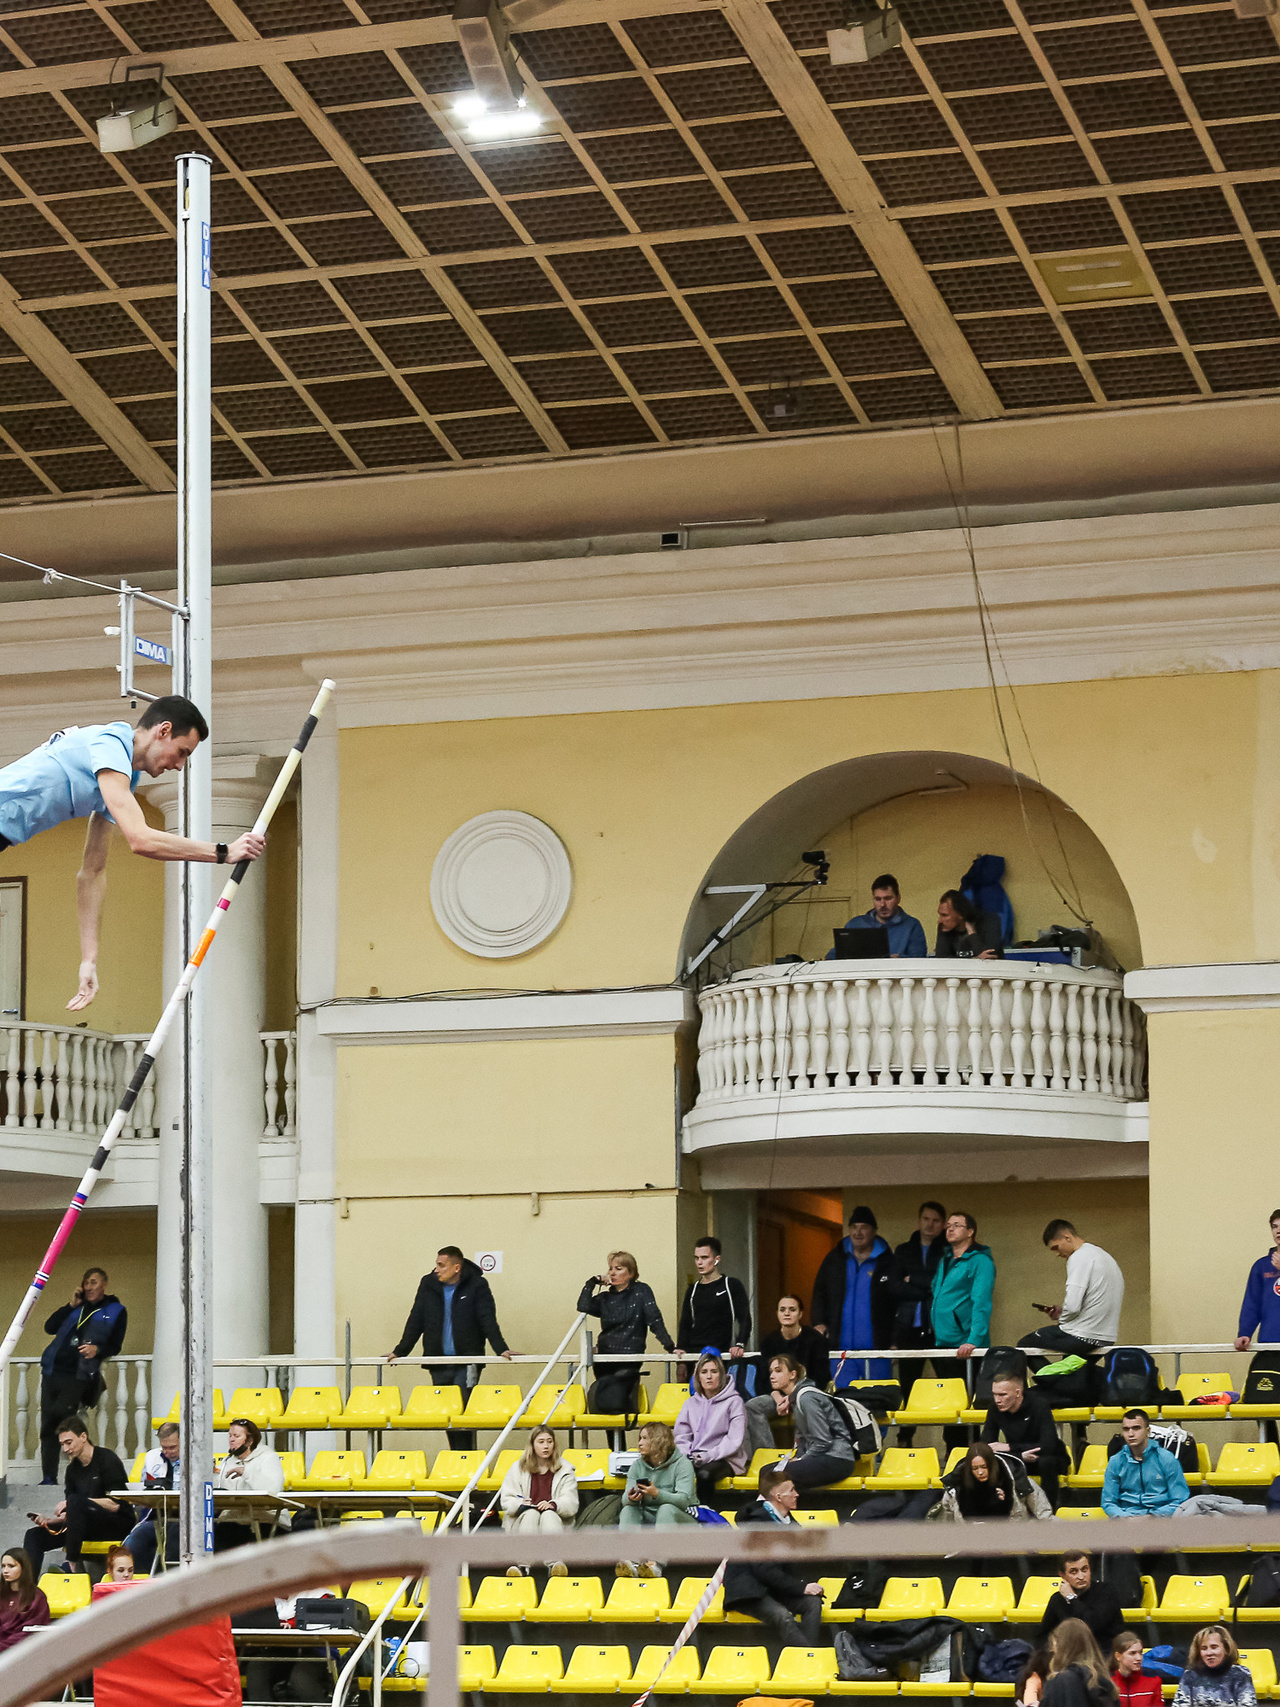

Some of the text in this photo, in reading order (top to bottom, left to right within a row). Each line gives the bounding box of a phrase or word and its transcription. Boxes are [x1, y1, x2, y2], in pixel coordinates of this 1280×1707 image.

[203, 223, 211, 289] DIMA
[136, 637, 166, 663] DIMA
[205, 1484, 213, 1549] DIMA
